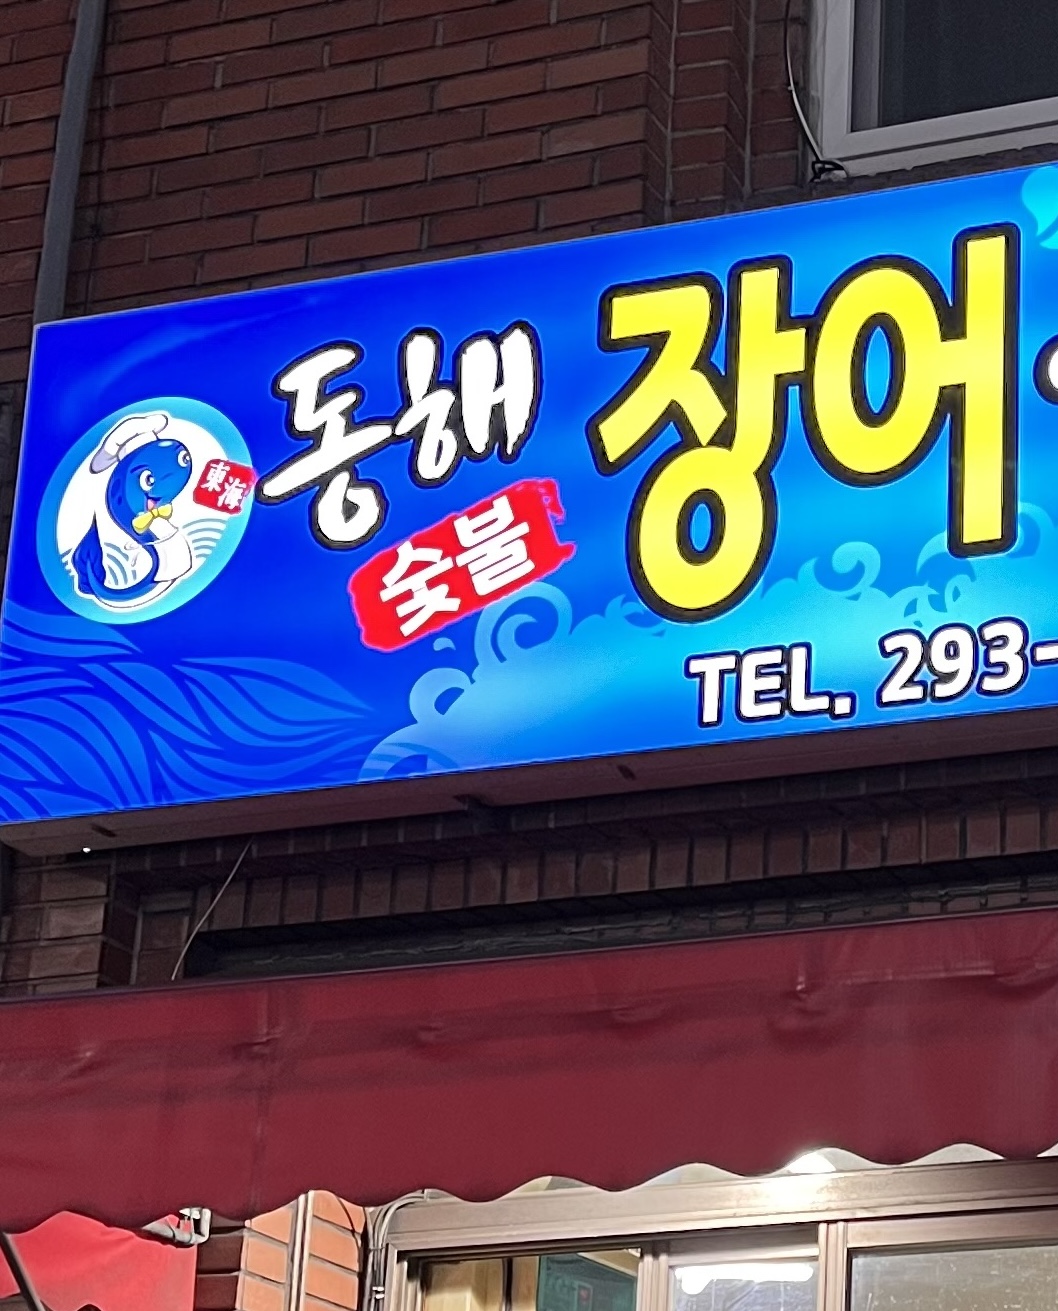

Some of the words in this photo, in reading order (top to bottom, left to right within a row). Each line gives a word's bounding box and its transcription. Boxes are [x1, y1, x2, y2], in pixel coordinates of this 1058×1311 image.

[258, 322, 542, 549] 동해
[378, 495, 536, 640] 숯불
[686, 642, 856, 725] TEL.
